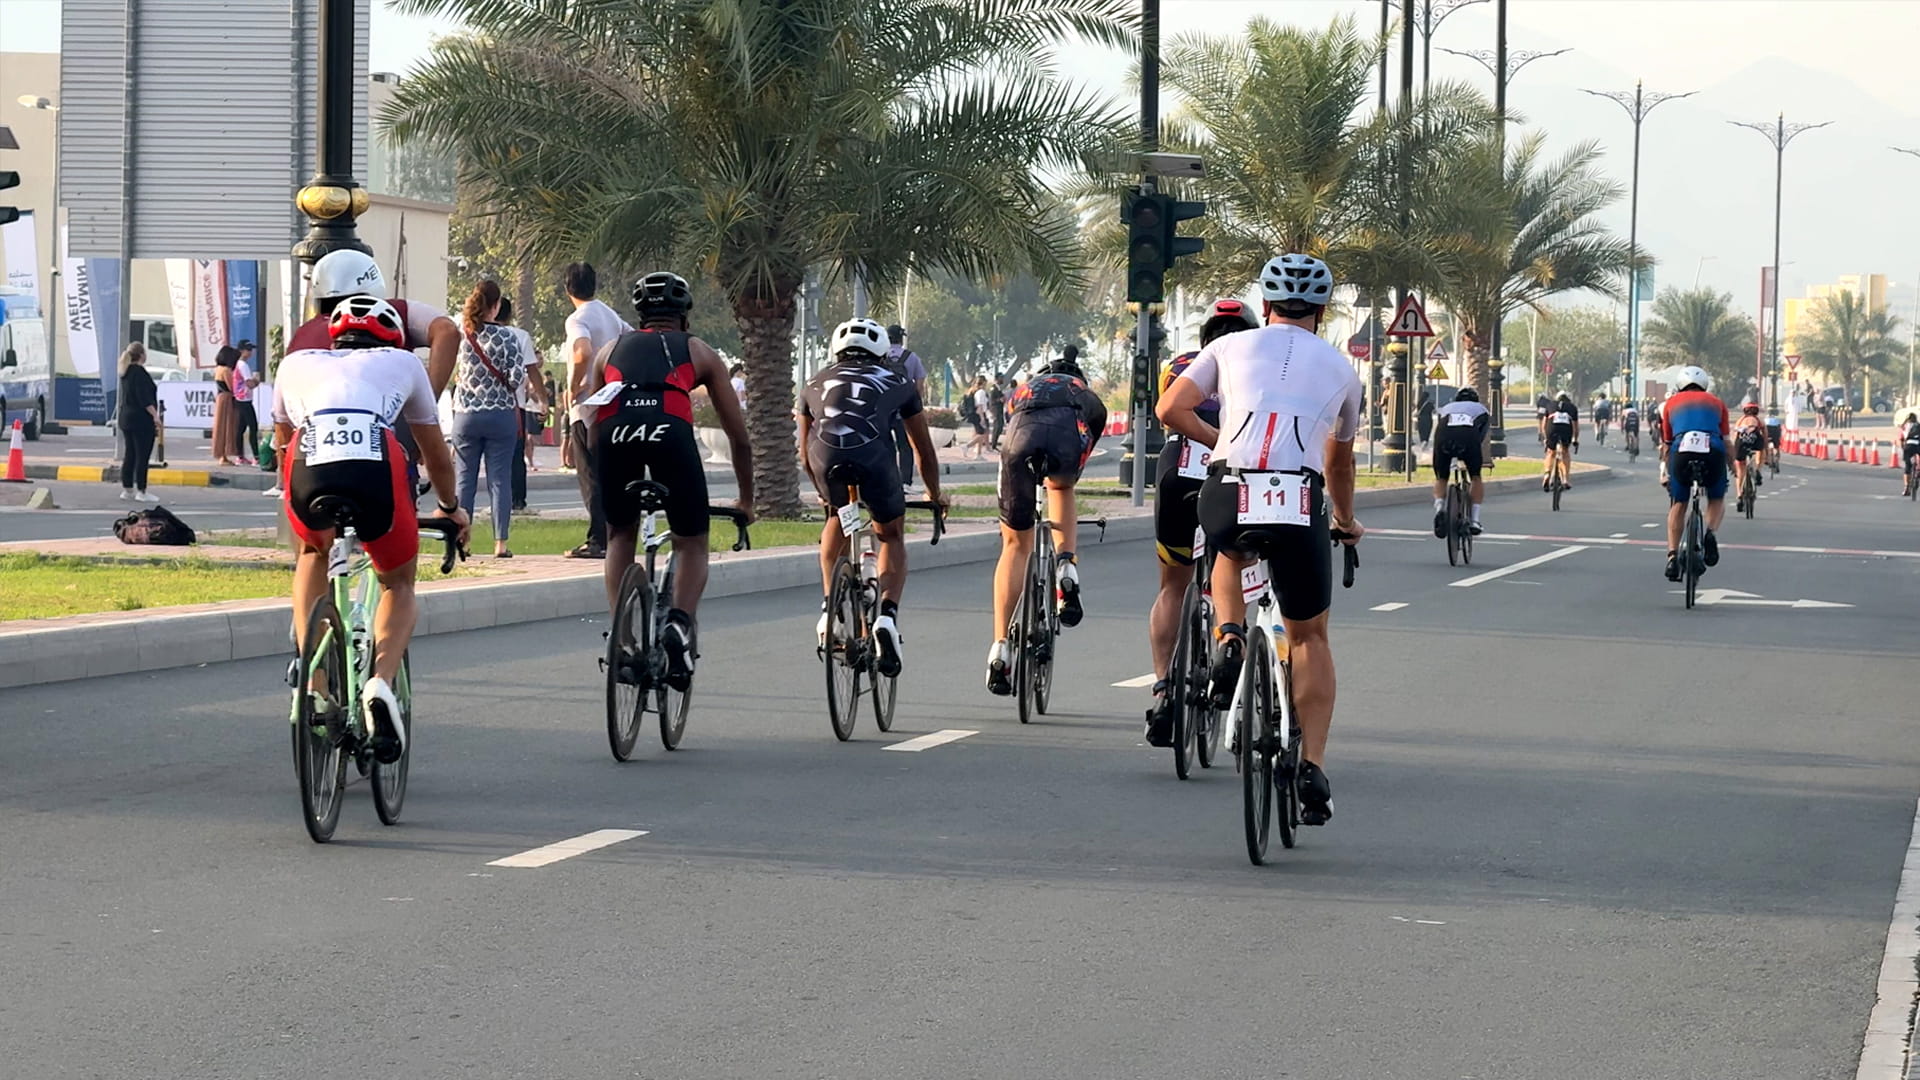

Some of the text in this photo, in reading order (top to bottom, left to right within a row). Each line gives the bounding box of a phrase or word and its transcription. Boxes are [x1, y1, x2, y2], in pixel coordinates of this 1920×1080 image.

[1350, 345, 1369, 353] STOP
[625, 399, 658, 407] A.SAAD
[323, 429, 363, 446] 430
[611, 424, 671, 444] UAE
[1690, 437, 1700, 445] 17
[1239, 485, 1247, 512] OLYMPIC
[1263, 490, 1285, 506] 11
[1244, 570, 1256, 584] 11
